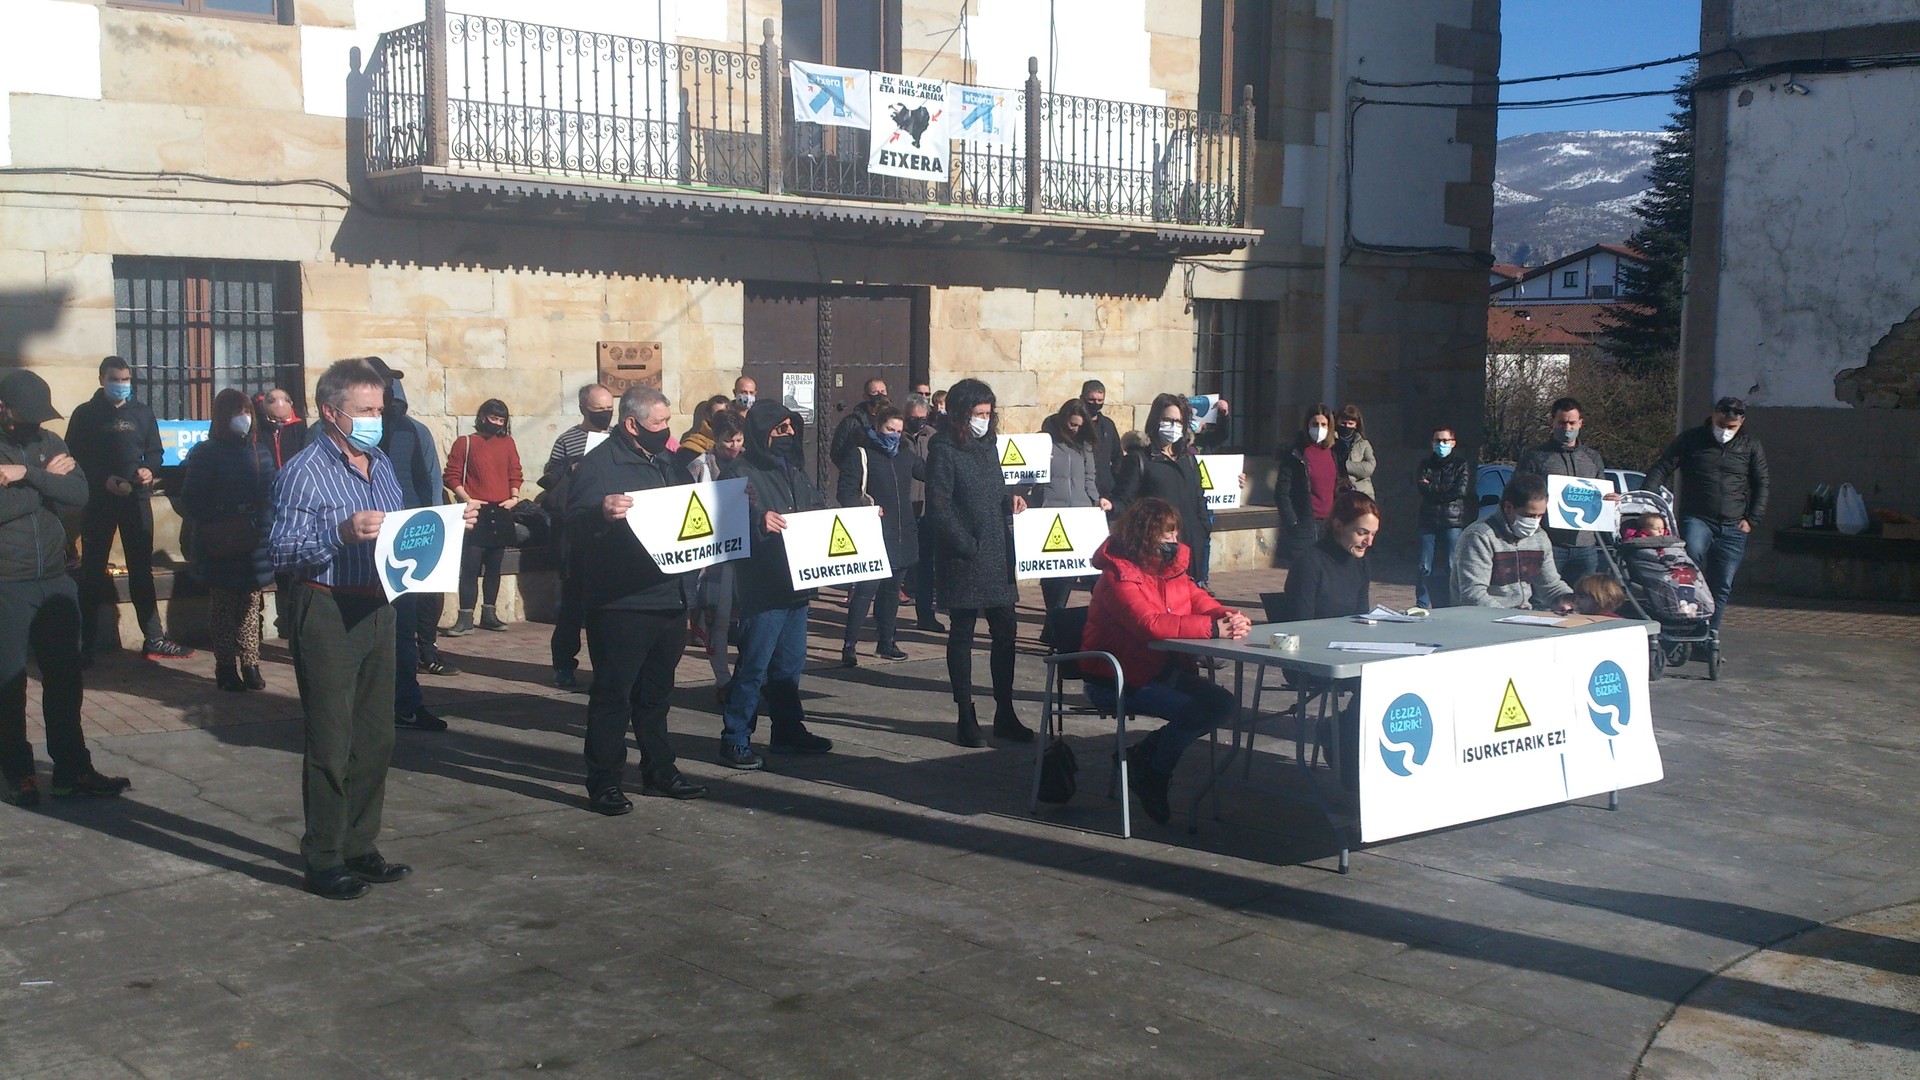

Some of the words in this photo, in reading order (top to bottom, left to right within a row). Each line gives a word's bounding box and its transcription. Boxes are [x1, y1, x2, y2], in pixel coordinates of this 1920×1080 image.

[815, 75, 840, 87] txera
[879, 84, 895, 93] ETA
[882, 76, 914, 89] EUKAL
[917, 82, 942, 93] PRESO
[879, 149, 944, 173] ETXERA
[1003, 470, 1034, 480] ETARIK
[1222, 494, 1236, 503] EZ!
[403, 523, 436, 539] LEZIZA
[400, 534, 434, 551] BIZIRIK!
[653, 541, 722, 566] SURKETARIK
[724, 537, 742, 553] EZ!
[799, 561, 868, 581] ISURKETARIK
[868, 559, 884, 572] EZ!
[1018, 558, 1086, 572] ISURKETARIK
[1594, 672, 1621, 686] LEZIZA
[1595, 682, 1622, 697] BIZIRIK!
[1390, 706, 1422, 721] LEZIZA
[1389, 718, 1422, 734] BIZIRIK!
[1463, 734, 1545, 763] ISURKETARIK
[1547, 729, 1566, 746] EZ!
